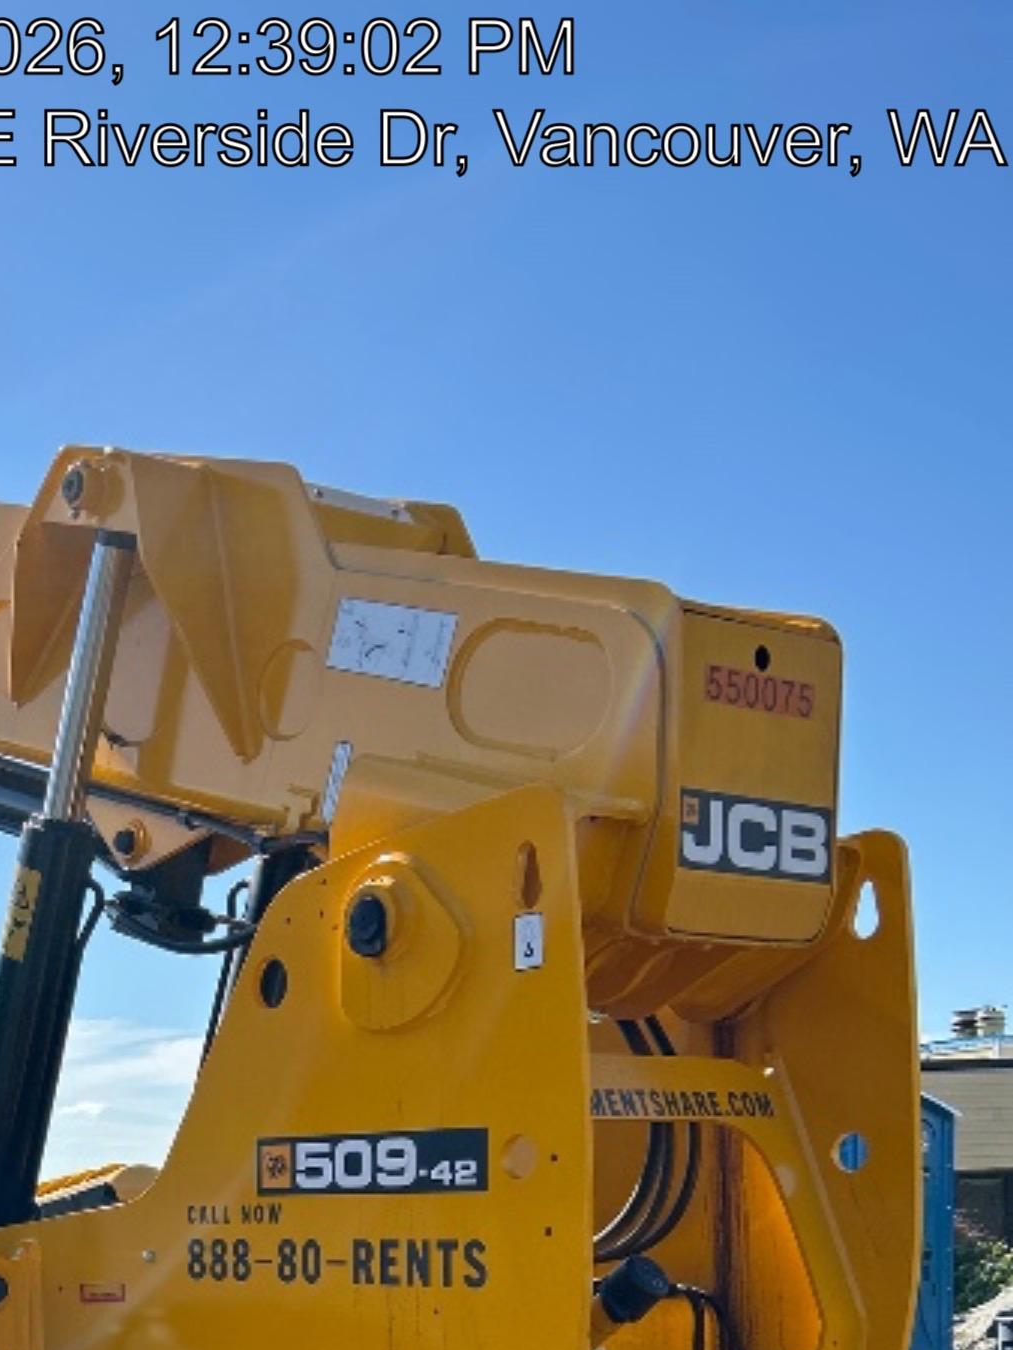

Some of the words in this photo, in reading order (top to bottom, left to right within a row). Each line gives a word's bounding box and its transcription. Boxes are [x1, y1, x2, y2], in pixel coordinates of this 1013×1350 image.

[707, 664, 815, 718] 550075
[681, 801, 828, 875] JCB
[187, 1205, 231, 1225] CALL
[240, 1203, 282, 1224] NOW
[187, 1237, 488, 1289] 888-80-RENTS
